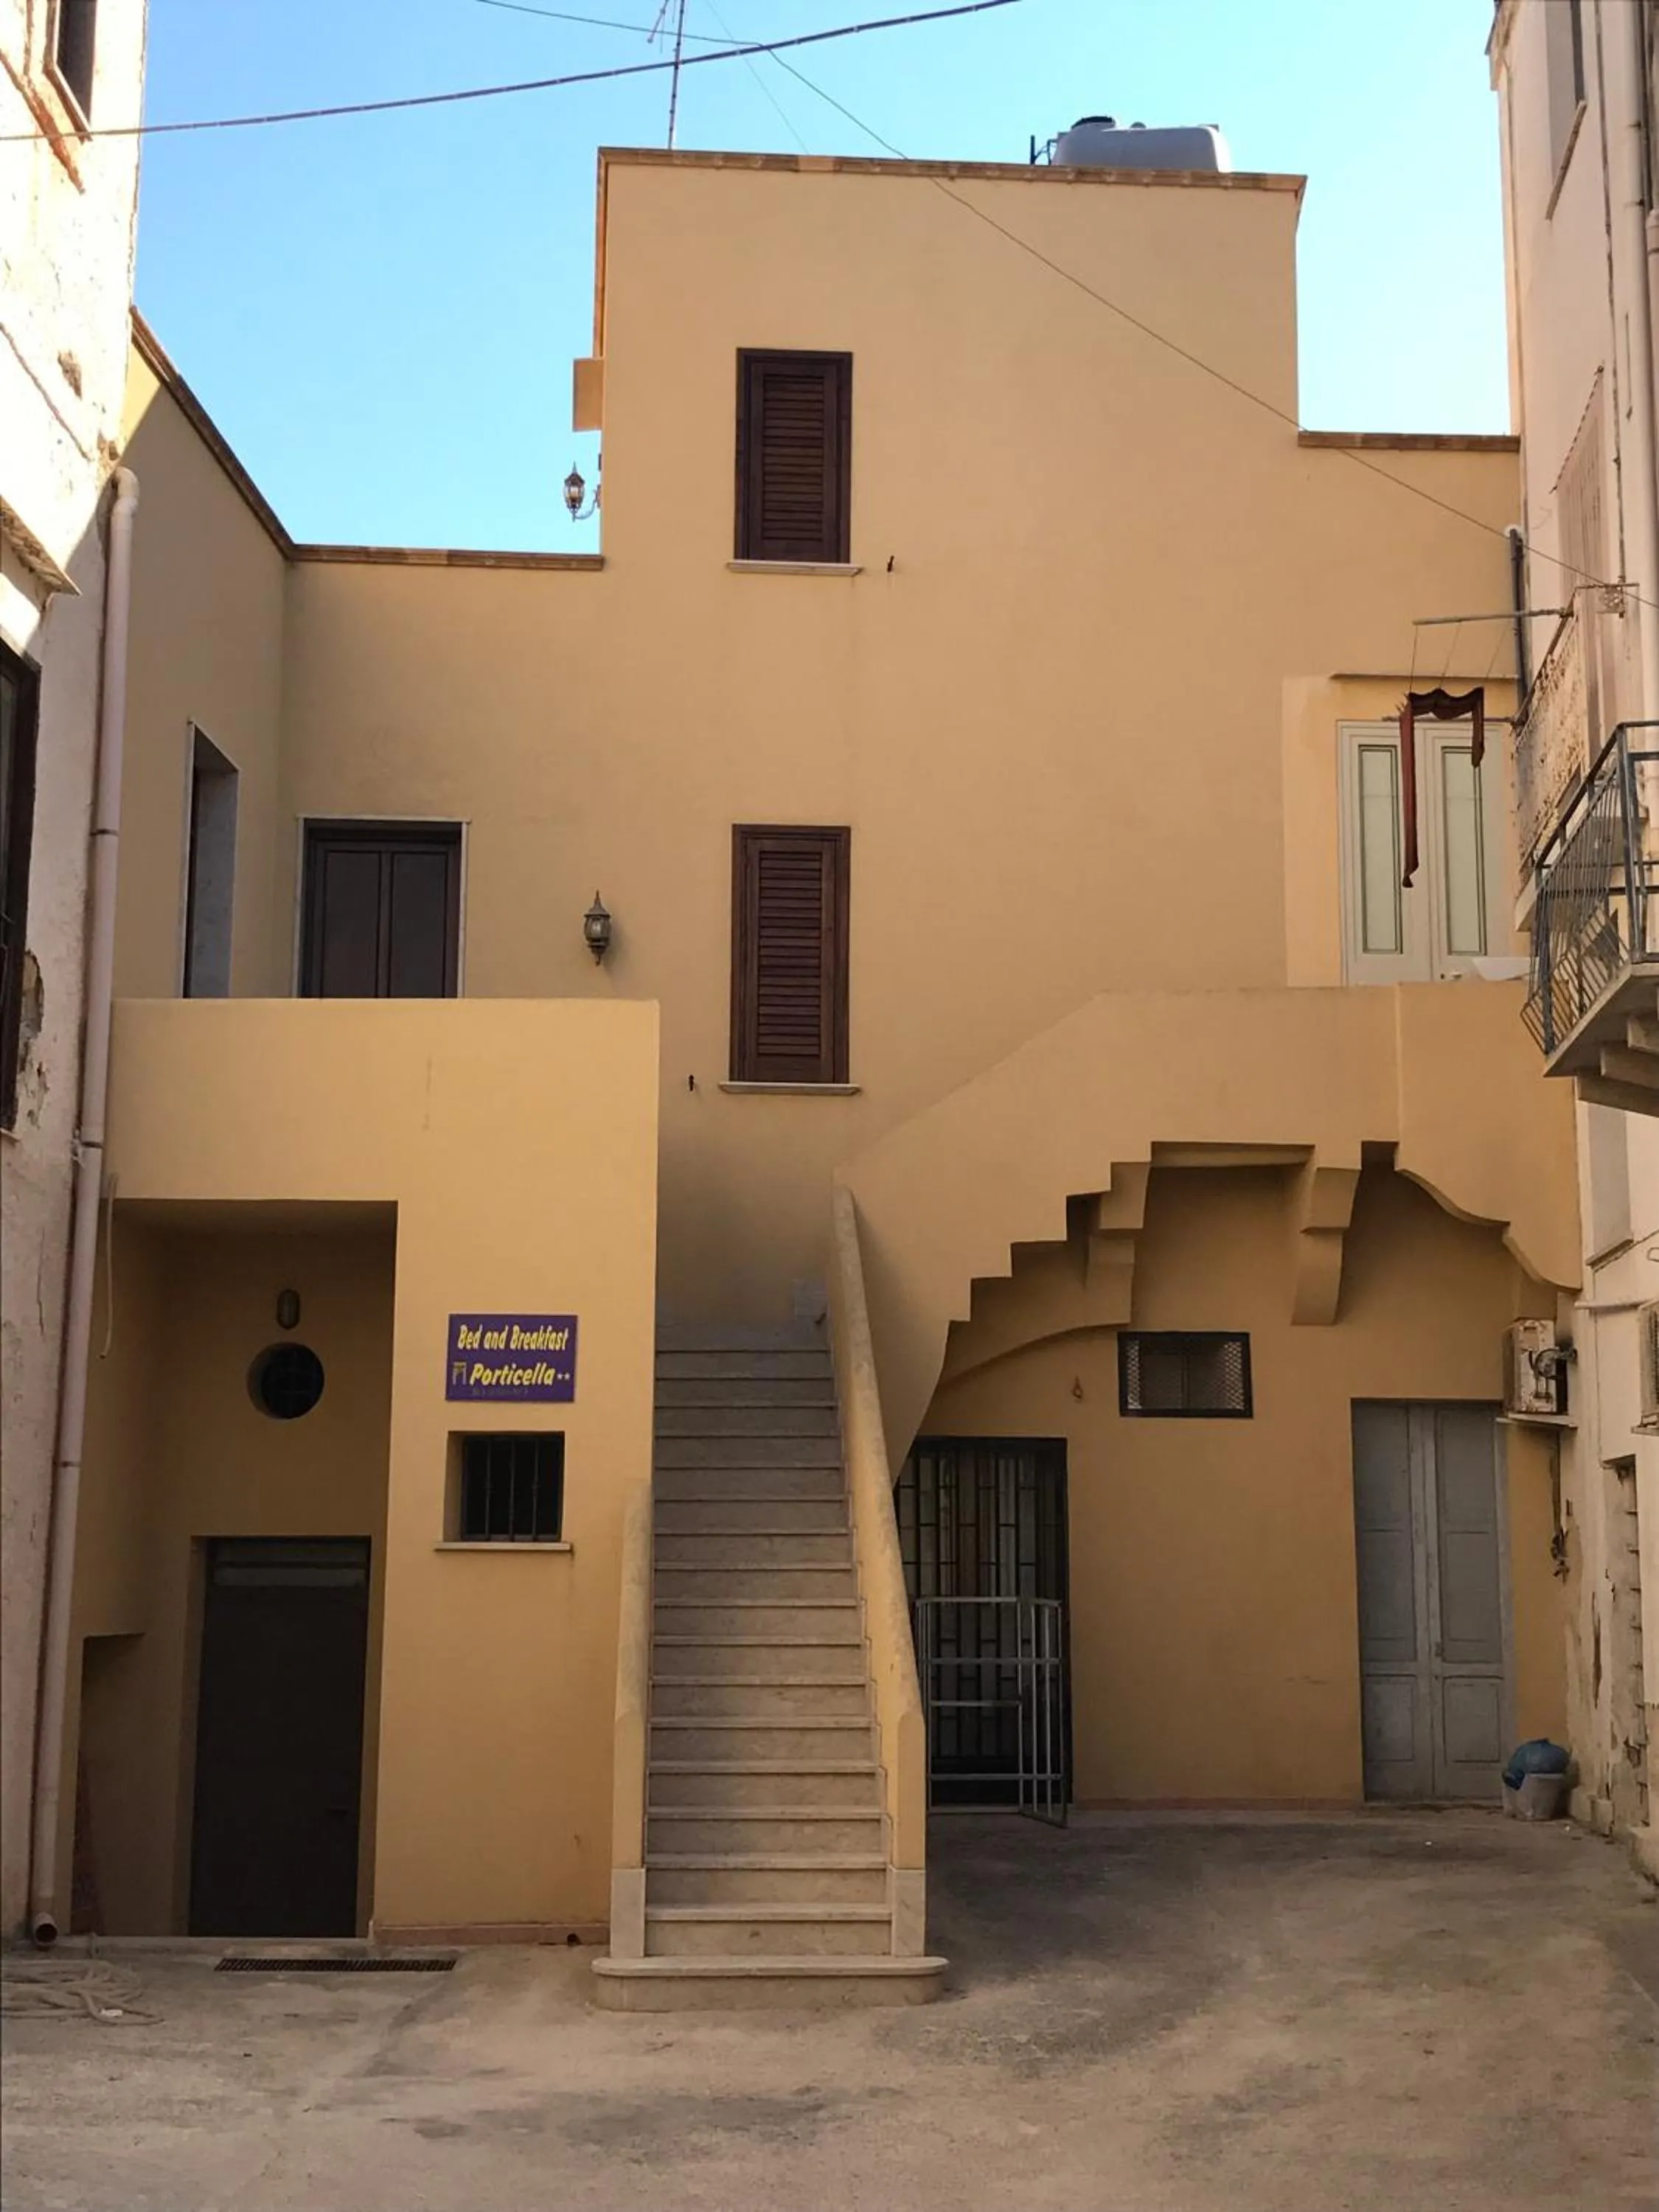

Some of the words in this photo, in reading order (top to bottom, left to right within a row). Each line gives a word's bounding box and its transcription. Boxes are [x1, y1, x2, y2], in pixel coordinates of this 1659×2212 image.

[457, 1324, 483, 1350] Bed
[483, 1325, 509, 1350] and
[509, 1324, 568, 1351] Breakfast
[469, 1363, 555, 1386] Porticella
